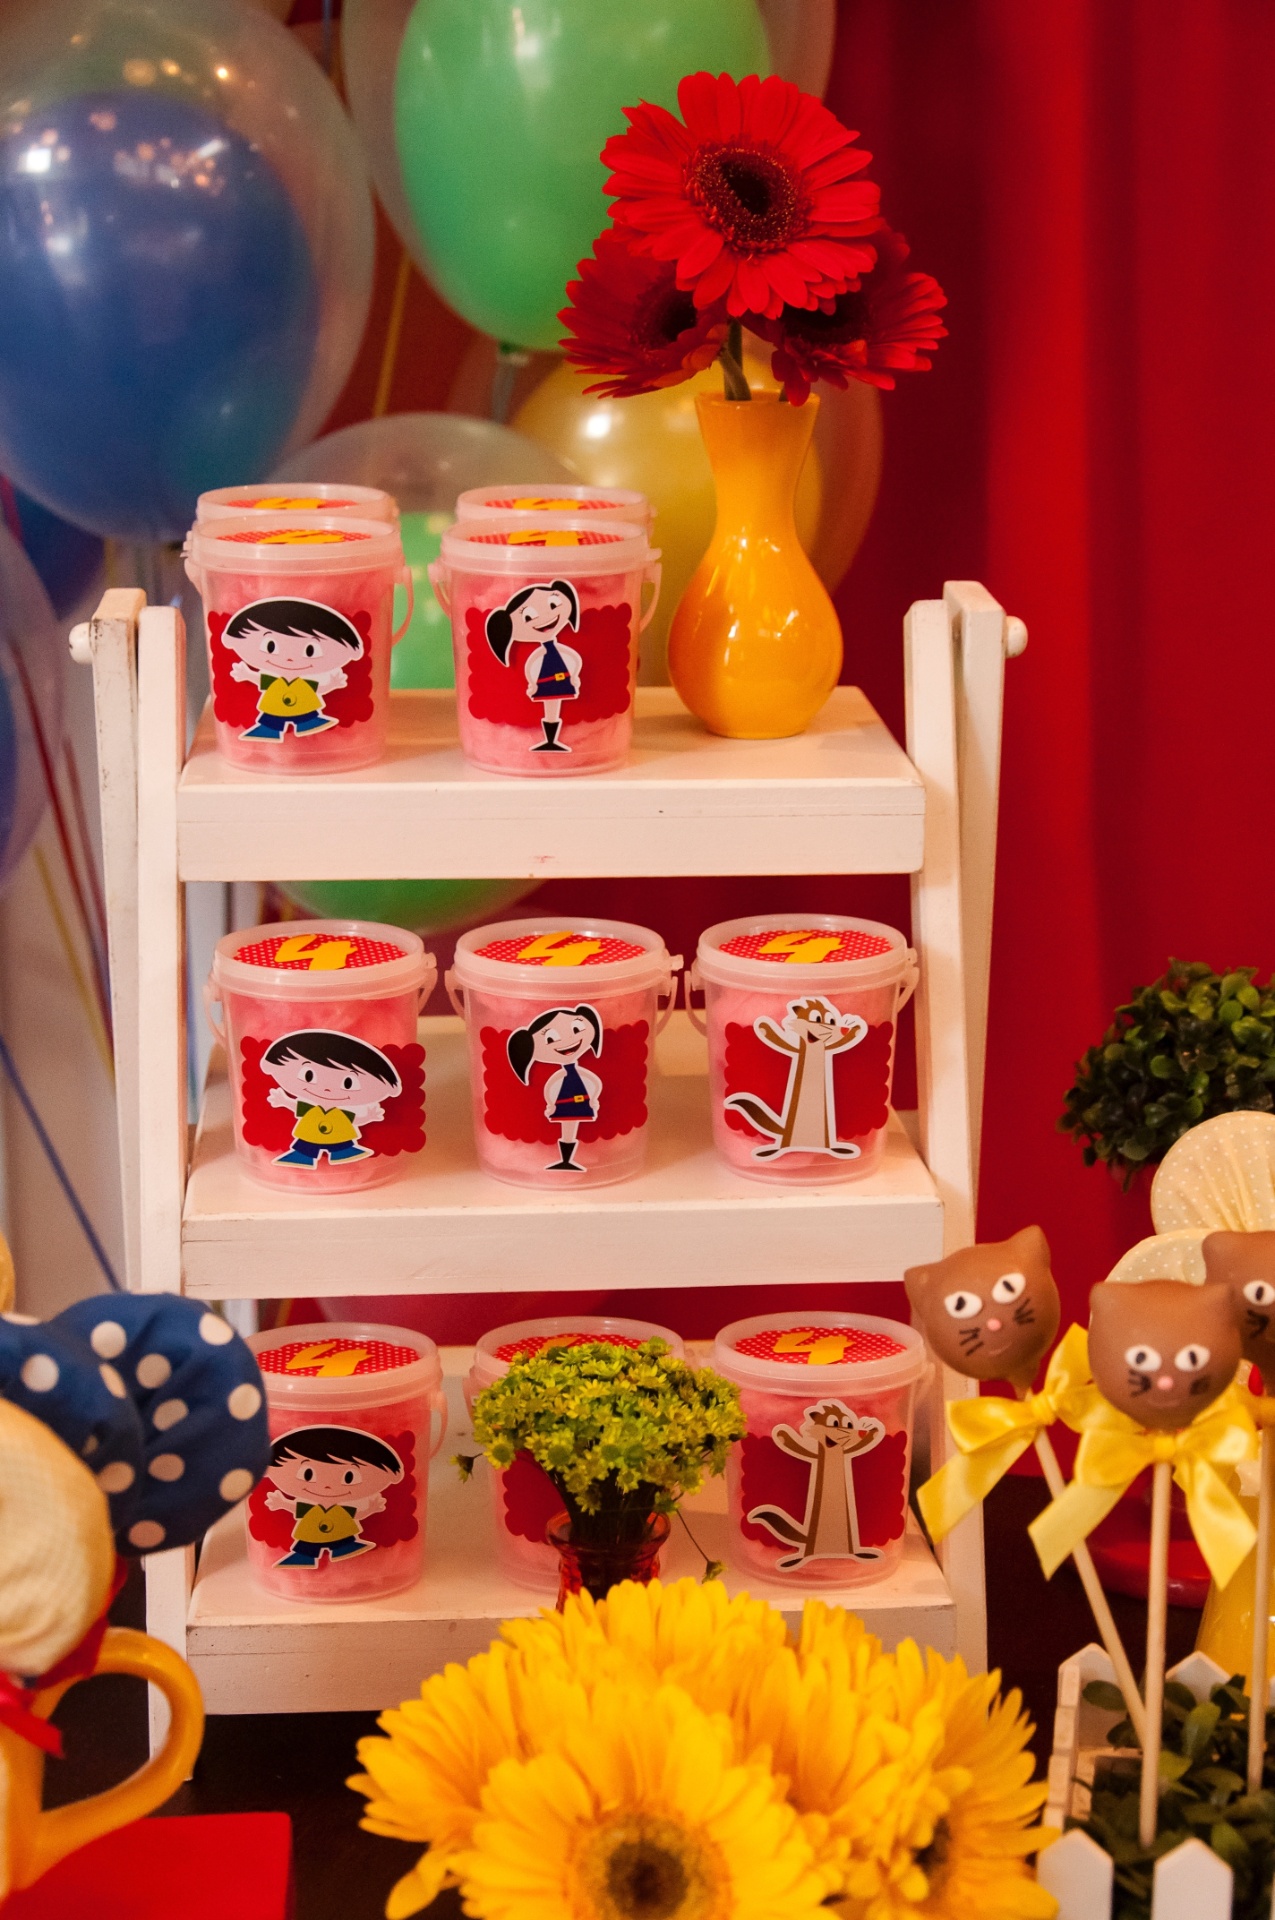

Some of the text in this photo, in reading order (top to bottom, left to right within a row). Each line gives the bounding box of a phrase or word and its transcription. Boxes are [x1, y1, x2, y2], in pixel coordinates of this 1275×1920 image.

[275, 933, 357, 970] 4
[517, 931, 603, 967] 4
[757, 932, 844, 964] 4
[286, 1340, 370, 1379] 4
[772, 1332, 851, 1366] 4
